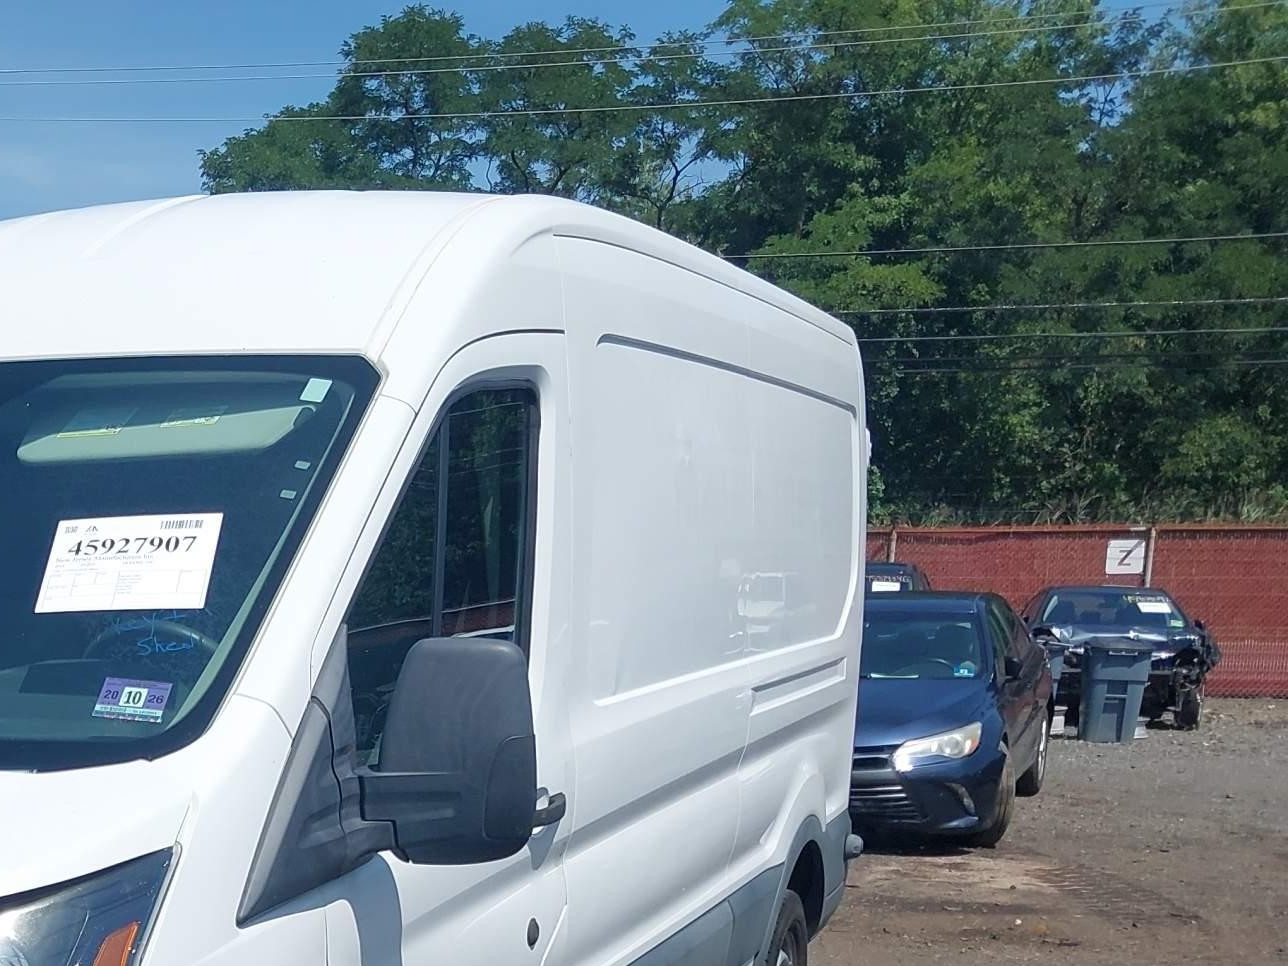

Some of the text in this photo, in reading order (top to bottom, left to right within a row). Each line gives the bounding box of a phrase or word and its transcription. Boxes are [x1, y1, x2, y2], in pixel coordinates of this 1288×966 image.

[67, 535, 198, 556] 45927907
[103, 689, 165, 705] 20 10 26
